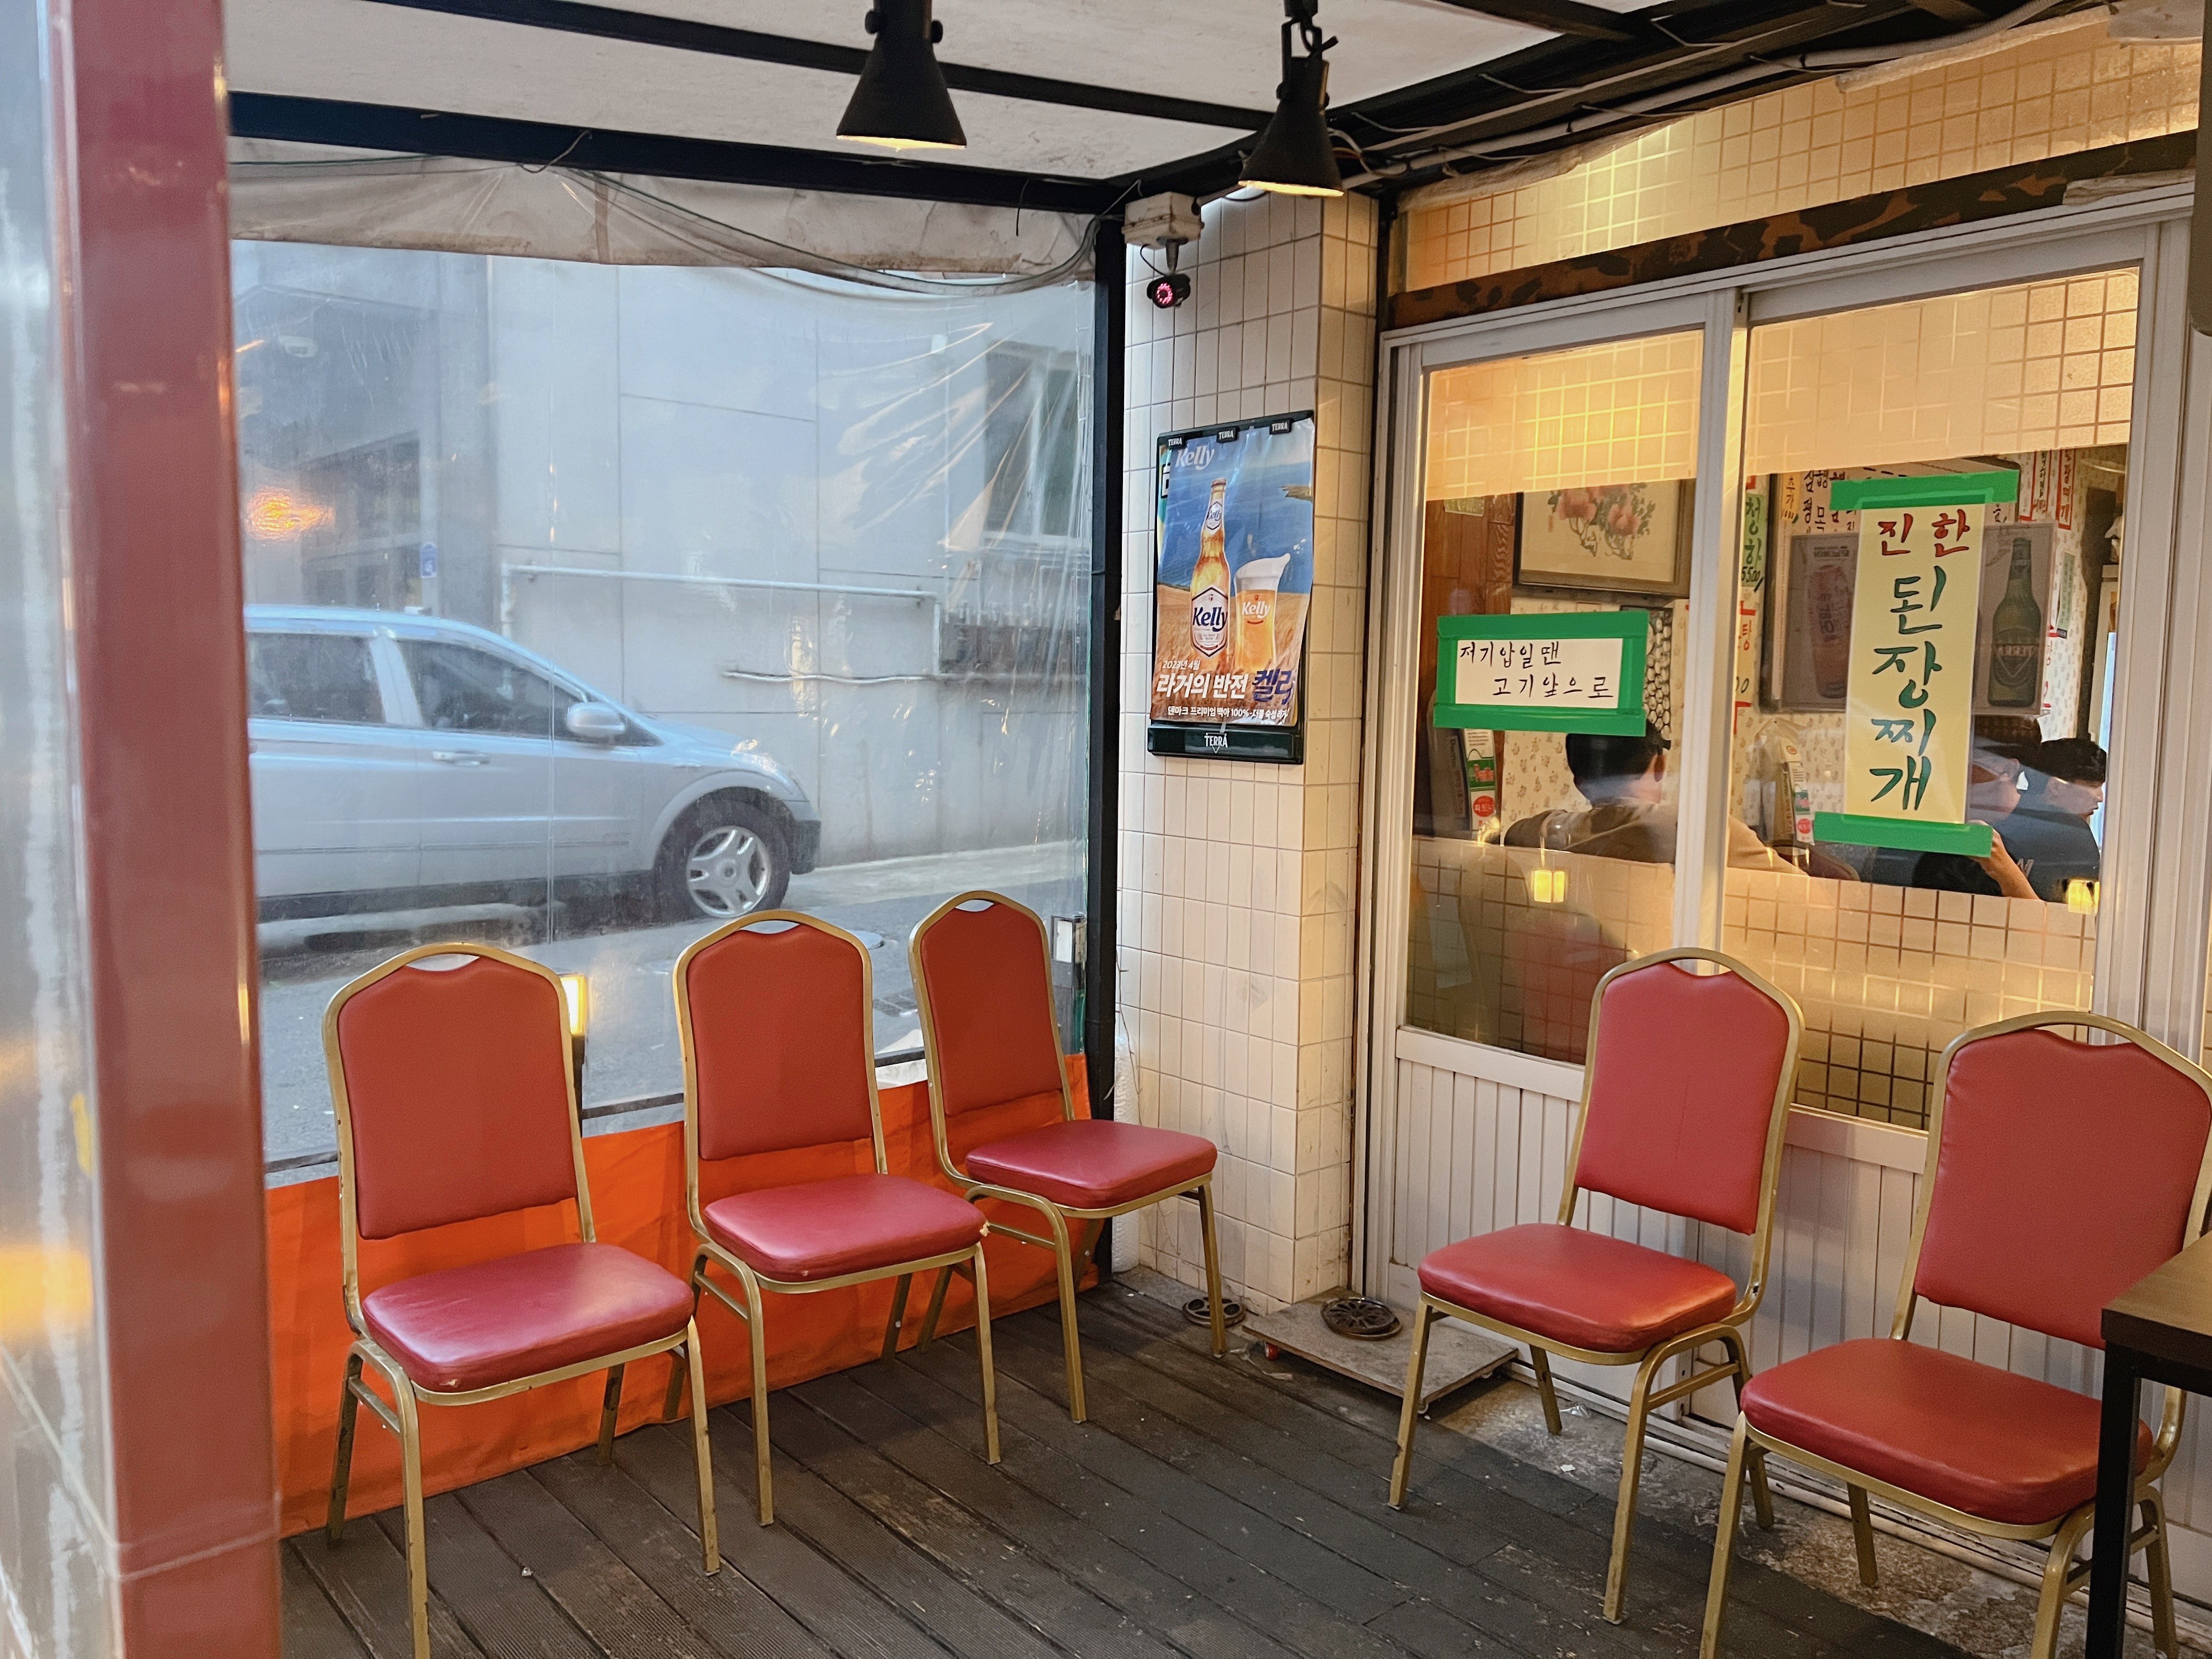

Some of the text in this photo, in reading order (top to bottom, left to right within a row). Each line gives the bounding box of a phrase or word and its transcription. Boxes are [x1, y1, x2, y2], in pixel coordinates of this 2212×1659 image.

[1272, 421, 1288, 432] TERRA
[1168, 437, 1182, 447] TERRA
[1218, 430, 1234, 440] TERRA
[1175, 445, 1215, 470] Kelly
[1242, 601, 1271, 618] Kelly
[1192, 606, 1228, 632] Kelly
[1162, 659, 1201, 670] 2023년 4월
[1156, 668, 1293, 705] 라거의 반전 켈리
[1870, 565, 1946, 811] 된장찌개
[1167, 706, 1189, 716] 덴마크
[1190, 706, 1216, 718] 프리미엄
[1204, 732, 1228, 748] TERRA
